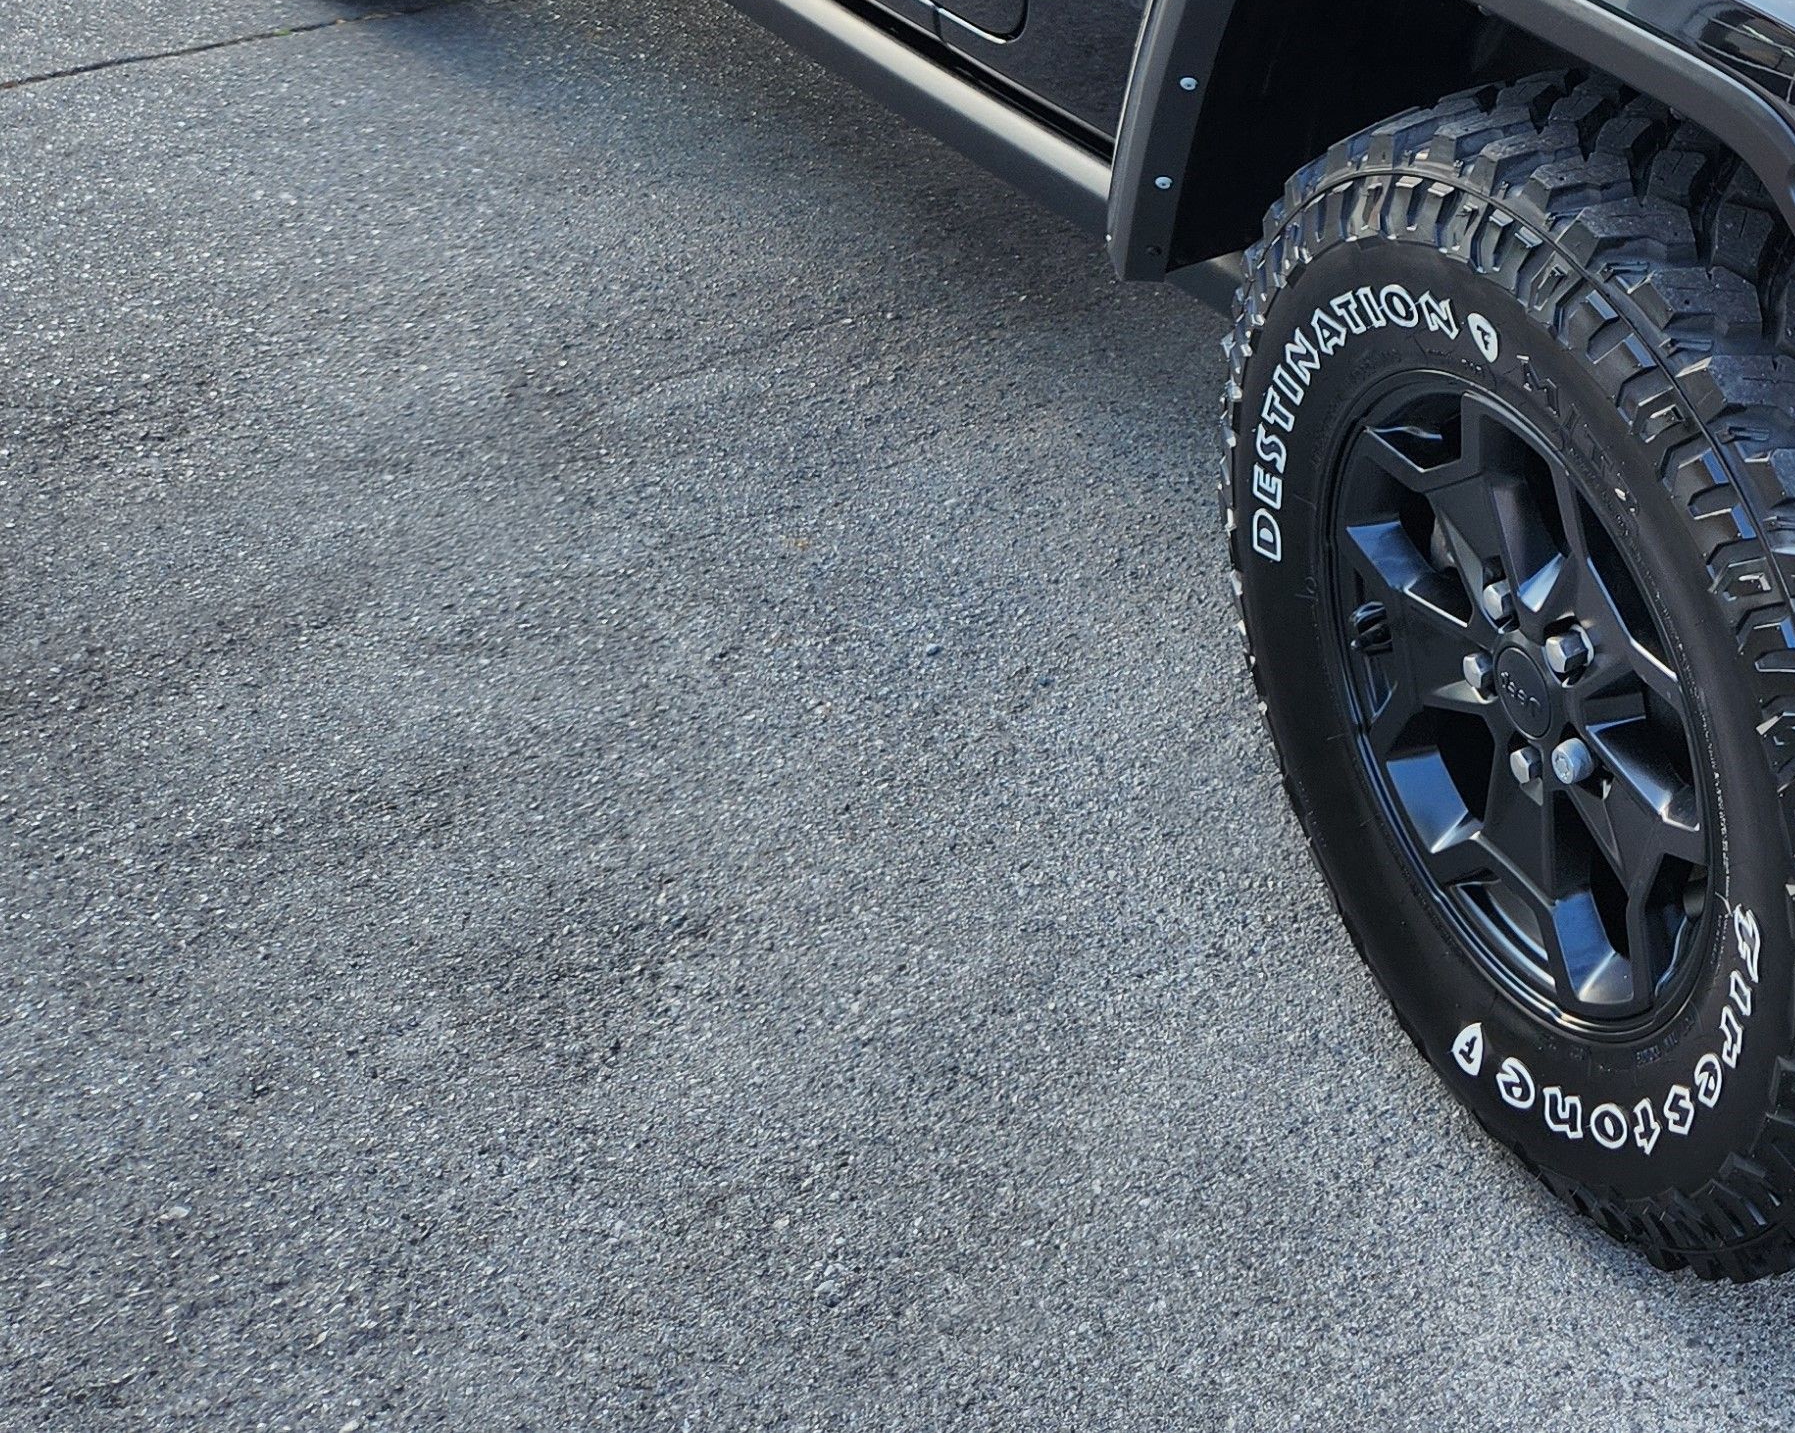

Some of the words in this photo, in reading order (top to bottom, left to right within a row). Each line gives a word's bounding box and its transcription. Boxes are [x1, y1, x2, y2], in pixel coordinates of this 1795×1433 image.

[1252, 283, 1460, 563] DESTINATION
[1500, 671, 1541, 717] Jeep
[1495, 904, 1761, 1156] Firestone
